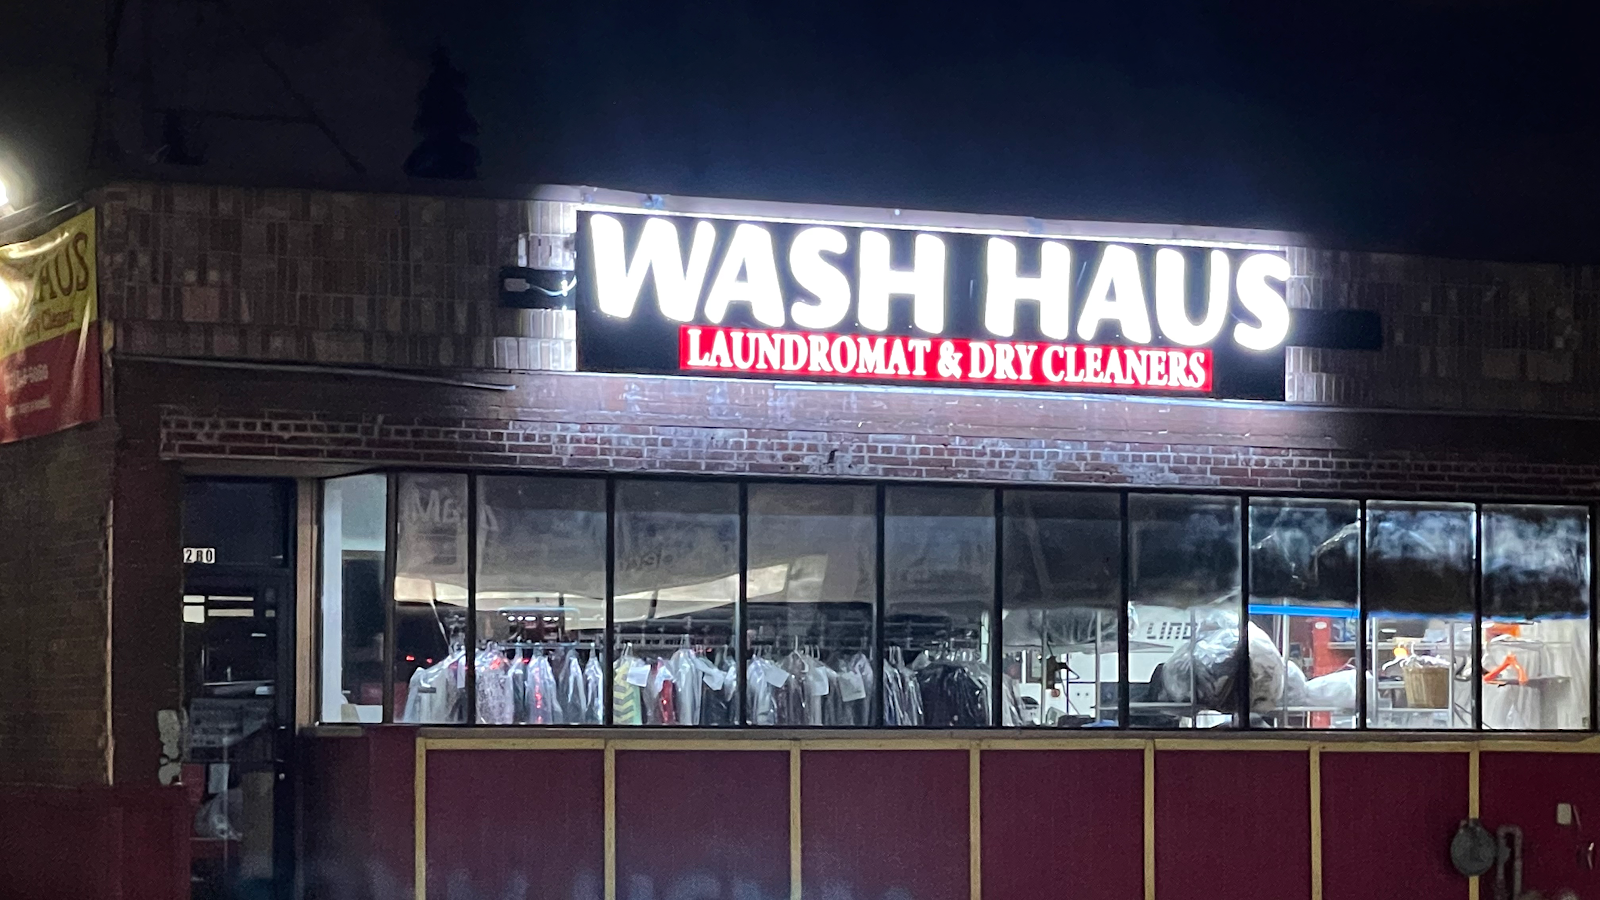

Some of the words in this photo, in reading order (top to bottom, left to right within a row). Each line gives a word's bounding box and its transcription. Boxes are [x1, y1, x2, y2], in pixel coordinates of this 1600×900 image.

[590, 213, 946, 334] WASH
[984, 236, 1292, 351] HAUS
[687, 328, 932, 377] LAUNDROMAT
[937, 341, 962, 379] &
[968, 341, 1038, 381] DRY
[1041, 345, 1206, 388] CLEANERS
